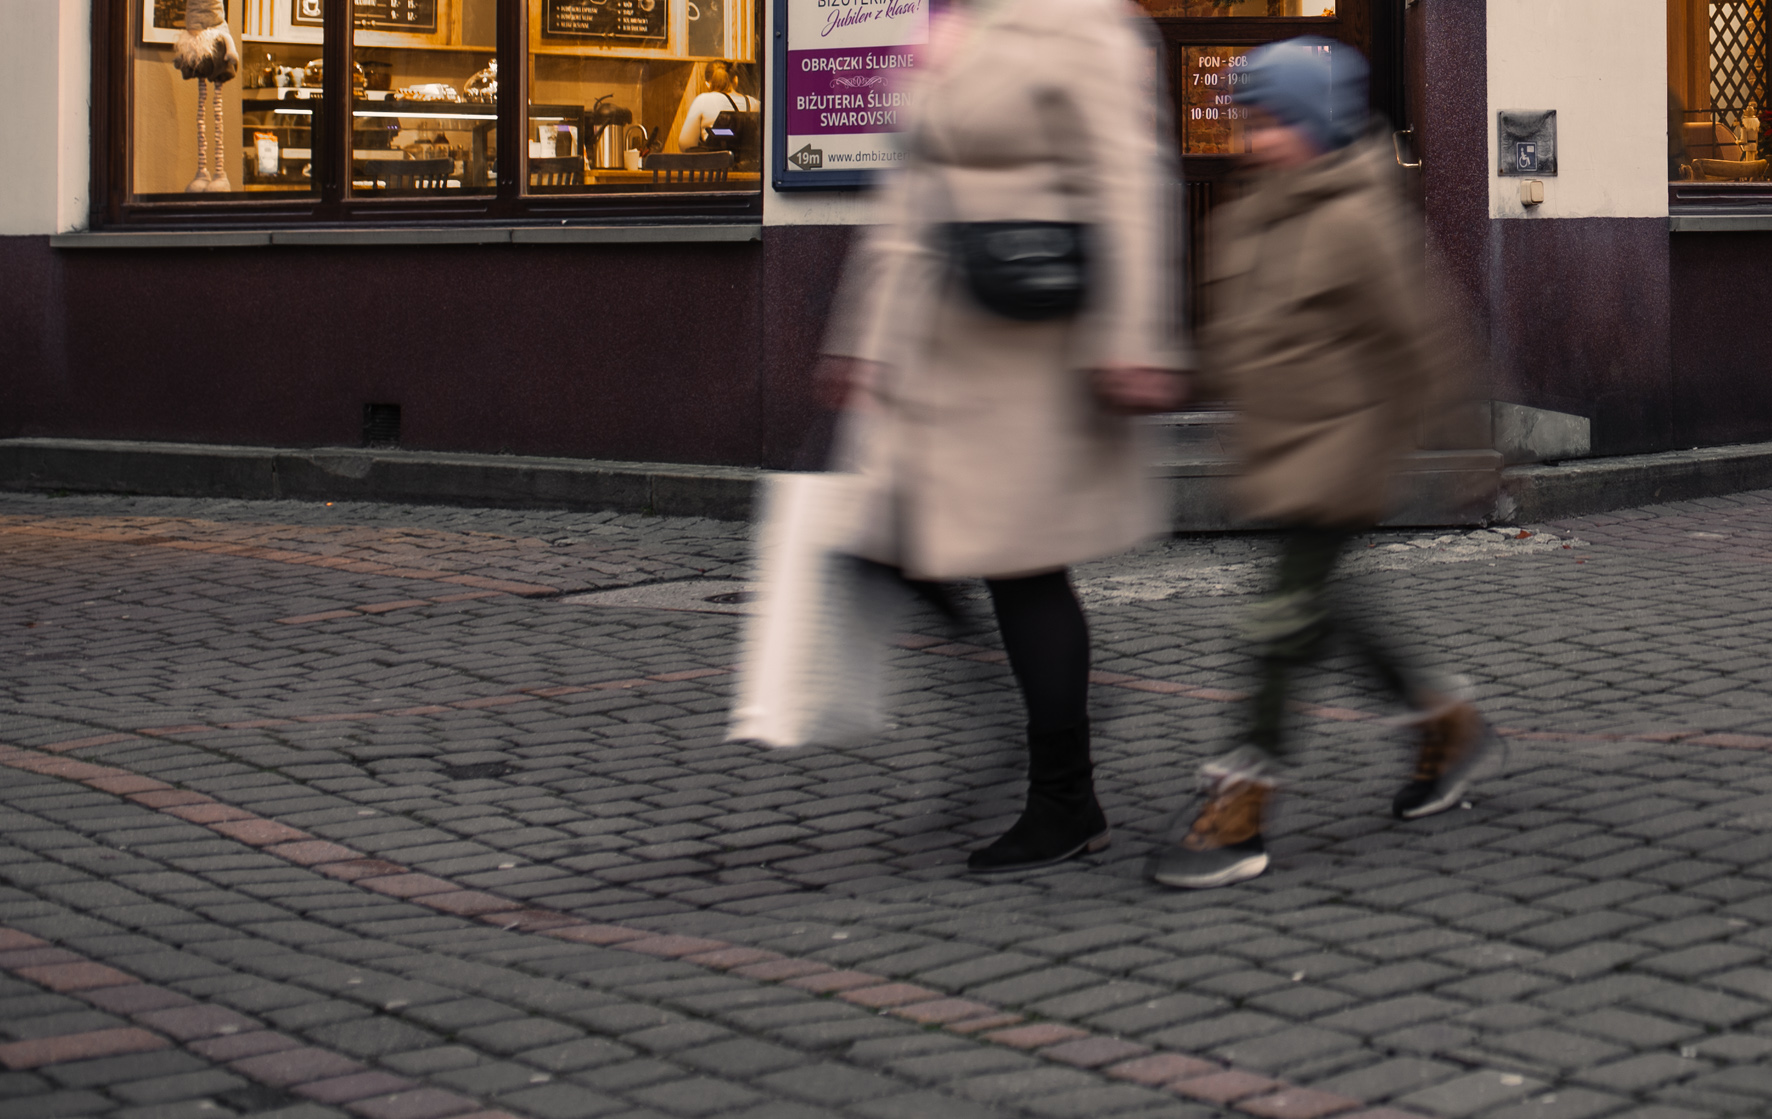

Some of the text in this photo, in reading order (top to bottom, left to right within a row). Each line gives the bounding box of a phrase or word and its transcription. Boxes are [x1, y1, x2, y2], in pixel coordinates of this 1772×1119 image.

[820, 6, 872, 37] Jubiler
[874, 9, 884, 20] z
[801, 52, 915, 74] OBRĄCZKI ŚLUBNE
[796, 92, 865, 110] BIŻUTERIA
[1215, 95, 1233, 105] ND
[820, 110, 898, 127] SWAROVSKI
[795, 149, 912, 165] 19m www.dmbizuteri
